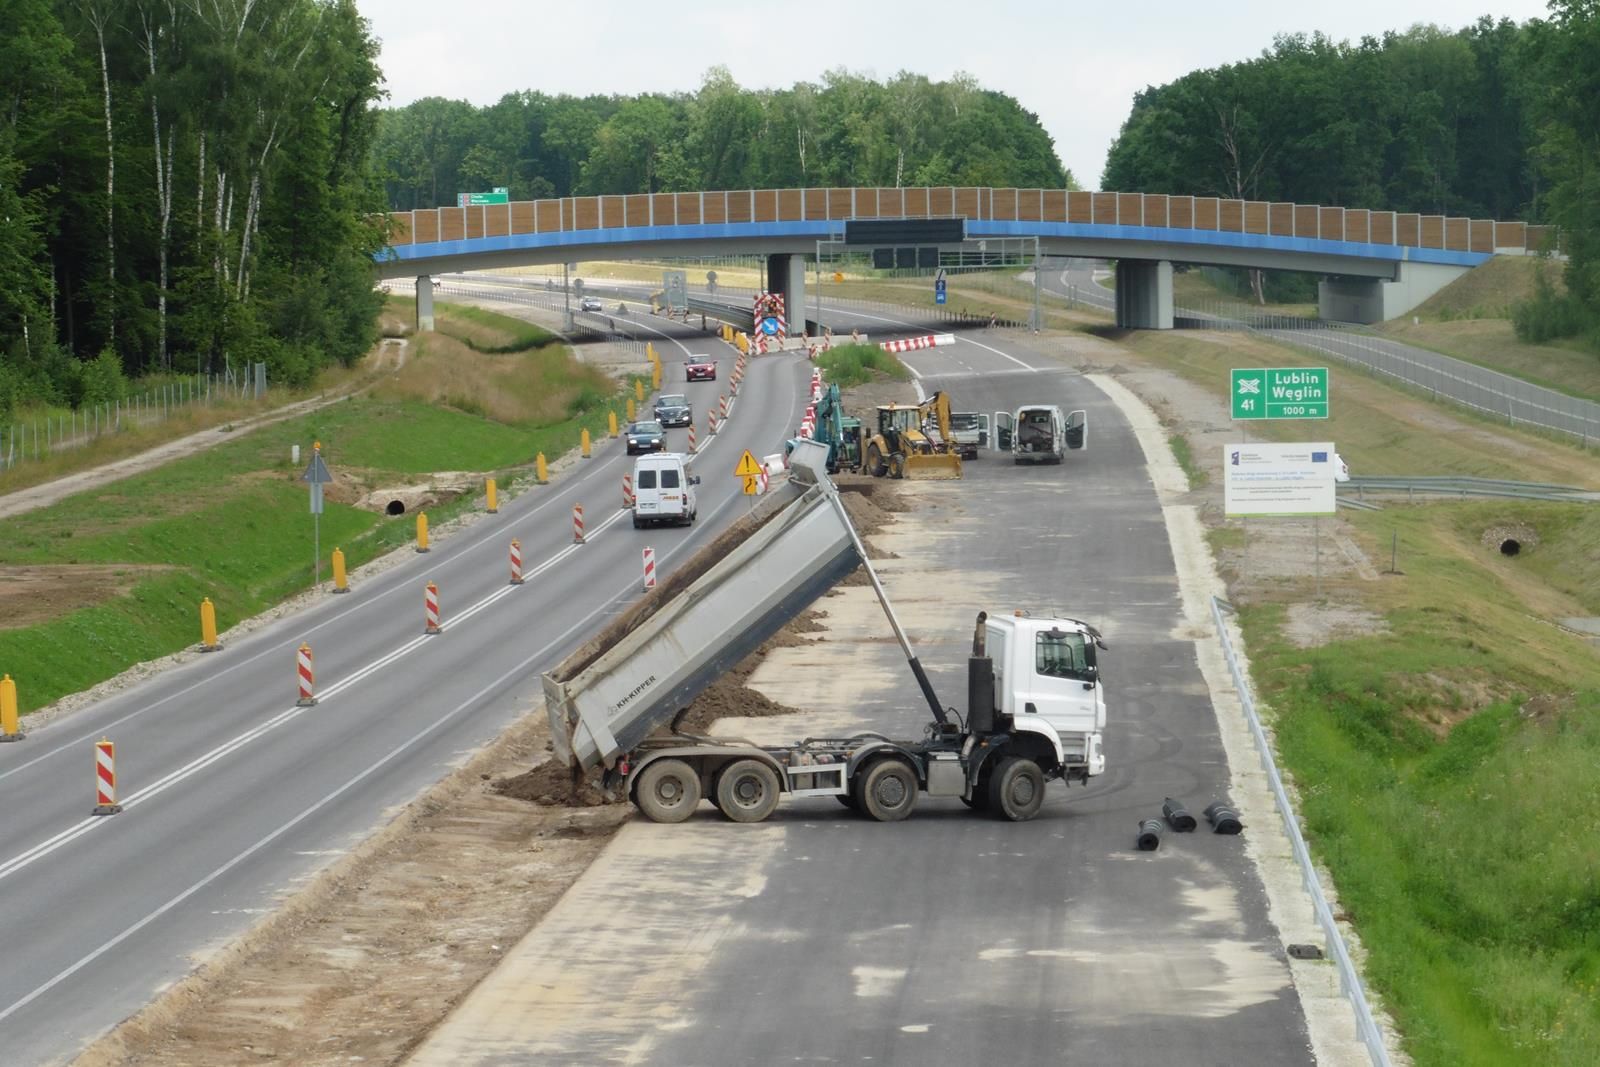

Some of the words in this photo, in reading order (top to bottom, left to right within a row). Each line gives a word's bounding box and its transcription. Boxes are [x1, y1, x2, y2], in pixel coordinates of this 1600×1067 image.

[1275, 372, 1319, 385] Lublin
[1272, 386, 1321, 401] Węglin
[1241, 399, 1254, 411] 41
[1283, 406, 1305, 415] 1000
[616, 675, 656, 709] KH-KIPPER
